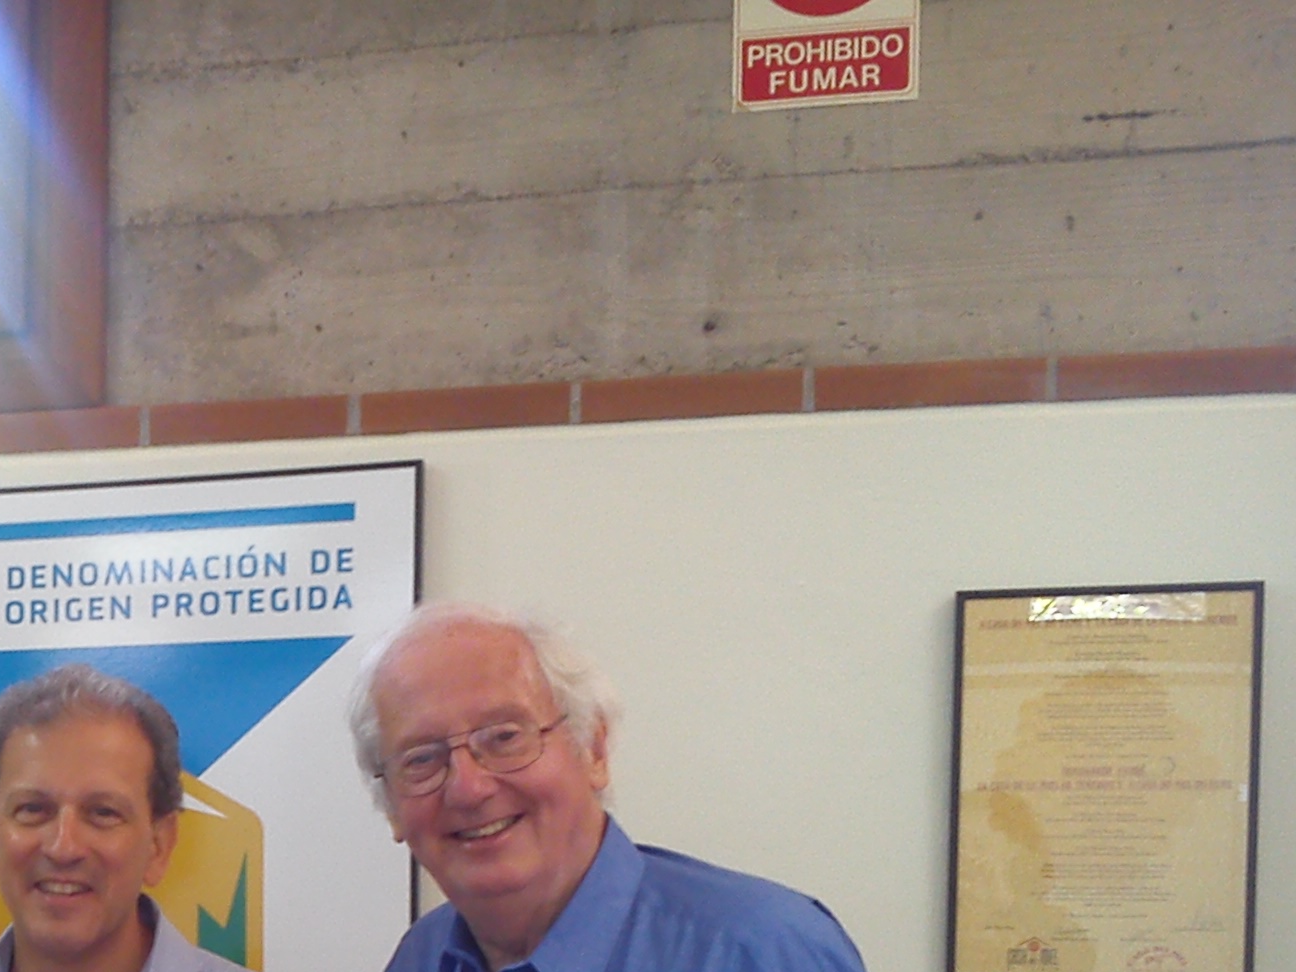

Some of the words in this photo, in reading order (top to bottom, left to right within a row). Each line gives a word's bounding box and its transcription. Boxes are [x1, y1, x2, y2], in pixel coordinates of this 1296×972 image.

[746, 33, 904, 69] PROHIBIDO
[768, 63, 881, 95] FUMAR
[6, 546, 288, 591] DENOMINACIÓN
[311, 547, 355, 574] DE
[4, 595, 133, 625] ORIGEN
[152, 584, 354, 618] PROTEGIDA
